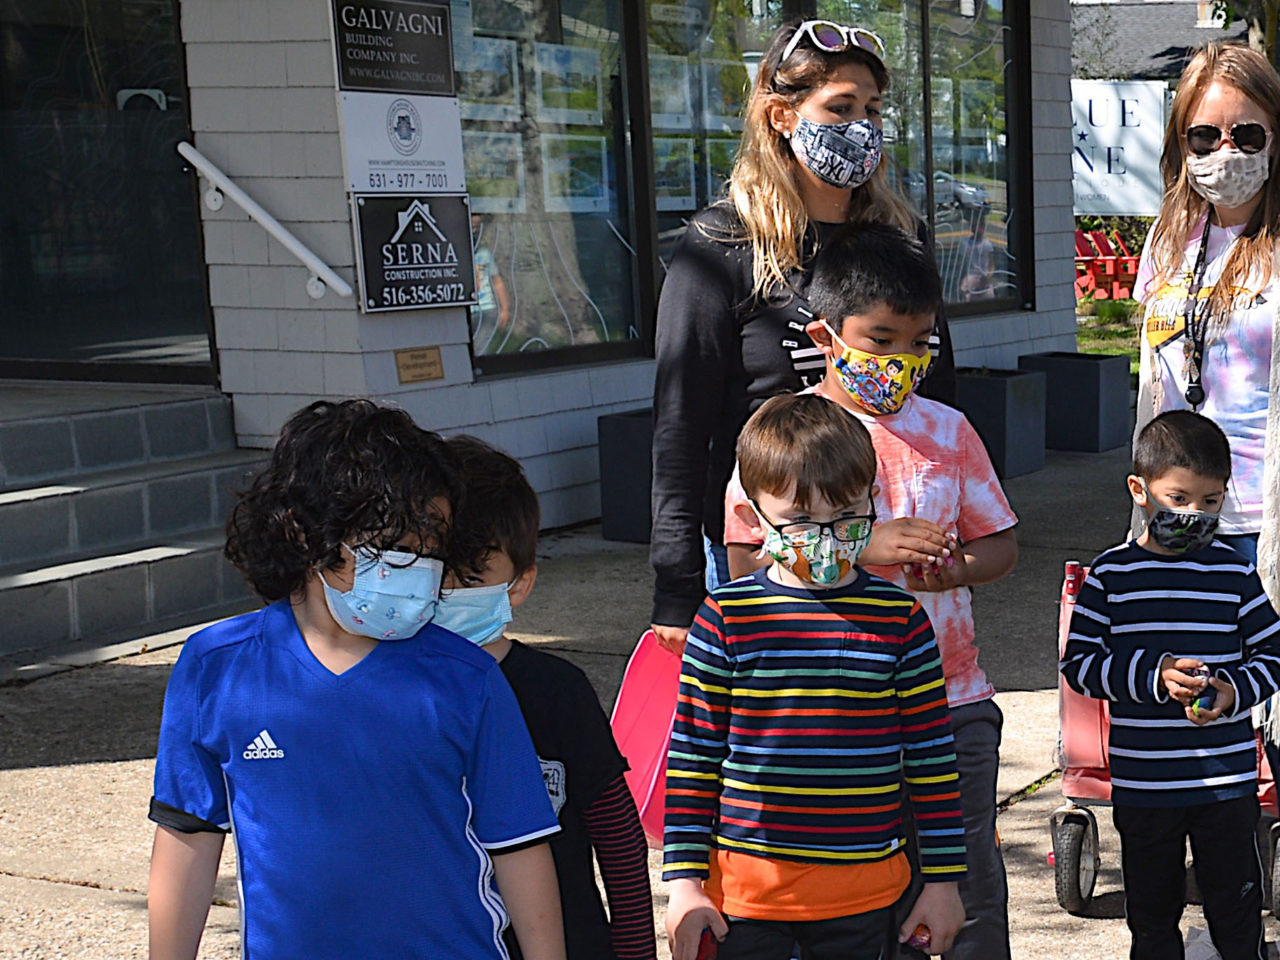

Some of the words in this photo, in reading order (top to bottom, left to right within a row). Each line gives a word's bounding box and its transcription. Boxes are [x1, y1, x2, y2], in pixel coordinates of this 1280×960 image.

[342, 6, 443, 36] GALVAGNI
[345, 33, 393, 47] BUILDING
[346, 48, 397, 63] COMPANY
[1073, 99, 1140, 127] UE
[369, 173, 386, 188] 631
[397, 173, 415, 188] 977
[425, 173, 448, 188] 7001
[382, 242, 458, 265] SERNA
[384, 268, 442, 281] CONSTRUCTION
[443, 267, 459, 279] INC.
[382, 283, 465, 305] 516-356-5072
[243, 747, 285, 760] adidas
